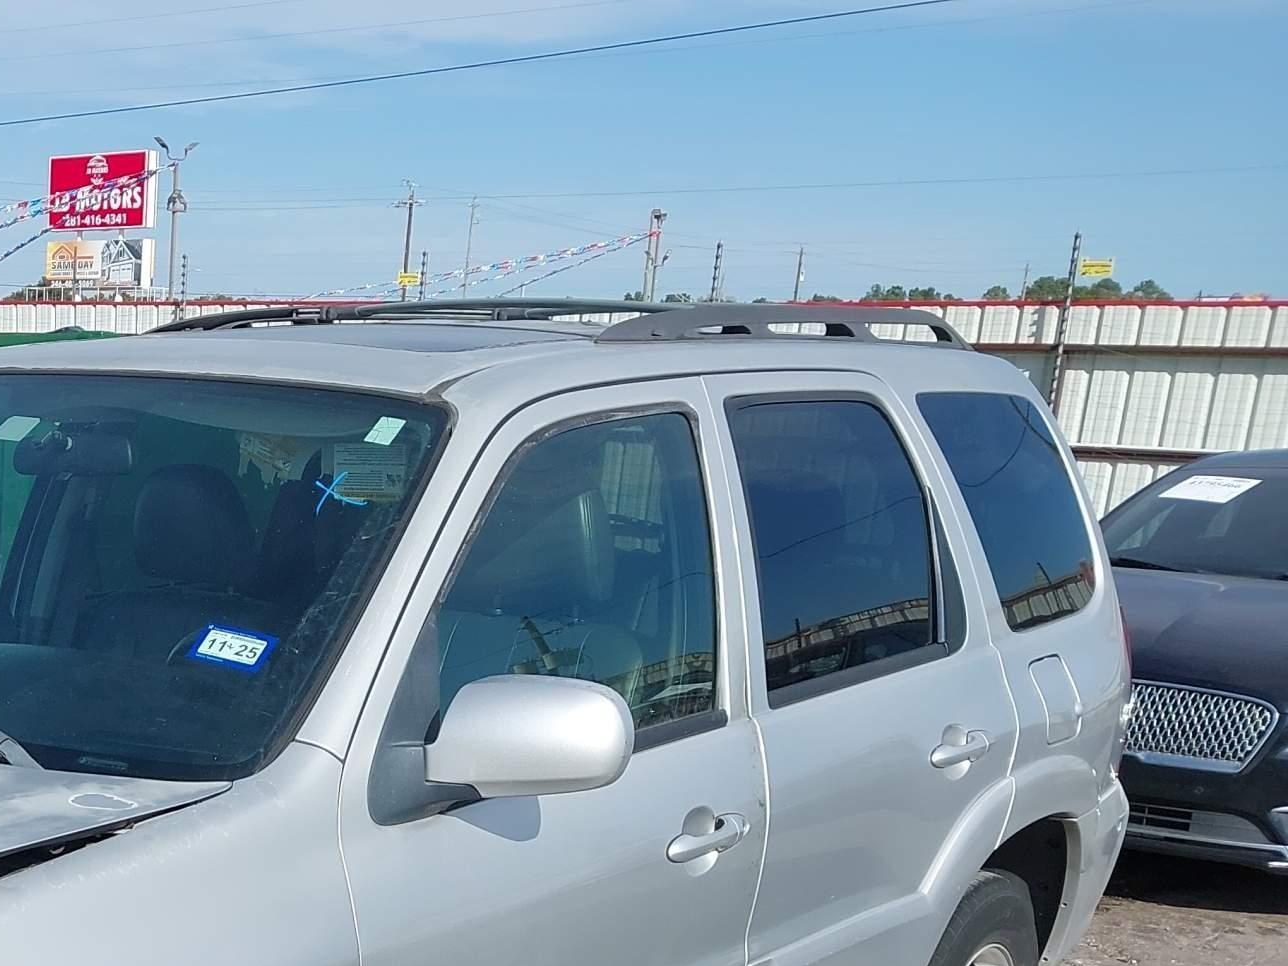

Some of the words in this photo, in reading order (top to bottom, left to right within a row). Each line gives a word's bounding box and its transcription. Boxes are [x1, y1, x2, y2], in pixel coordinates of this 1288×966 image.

[76, 187, 142, 212] MOTORS
[64, 213, 127, 228] 281-416-4341
[78, 260, 95, 269] DAY
[208, 638, 228, 653] 11
[234, 644, 260, 659] 25
